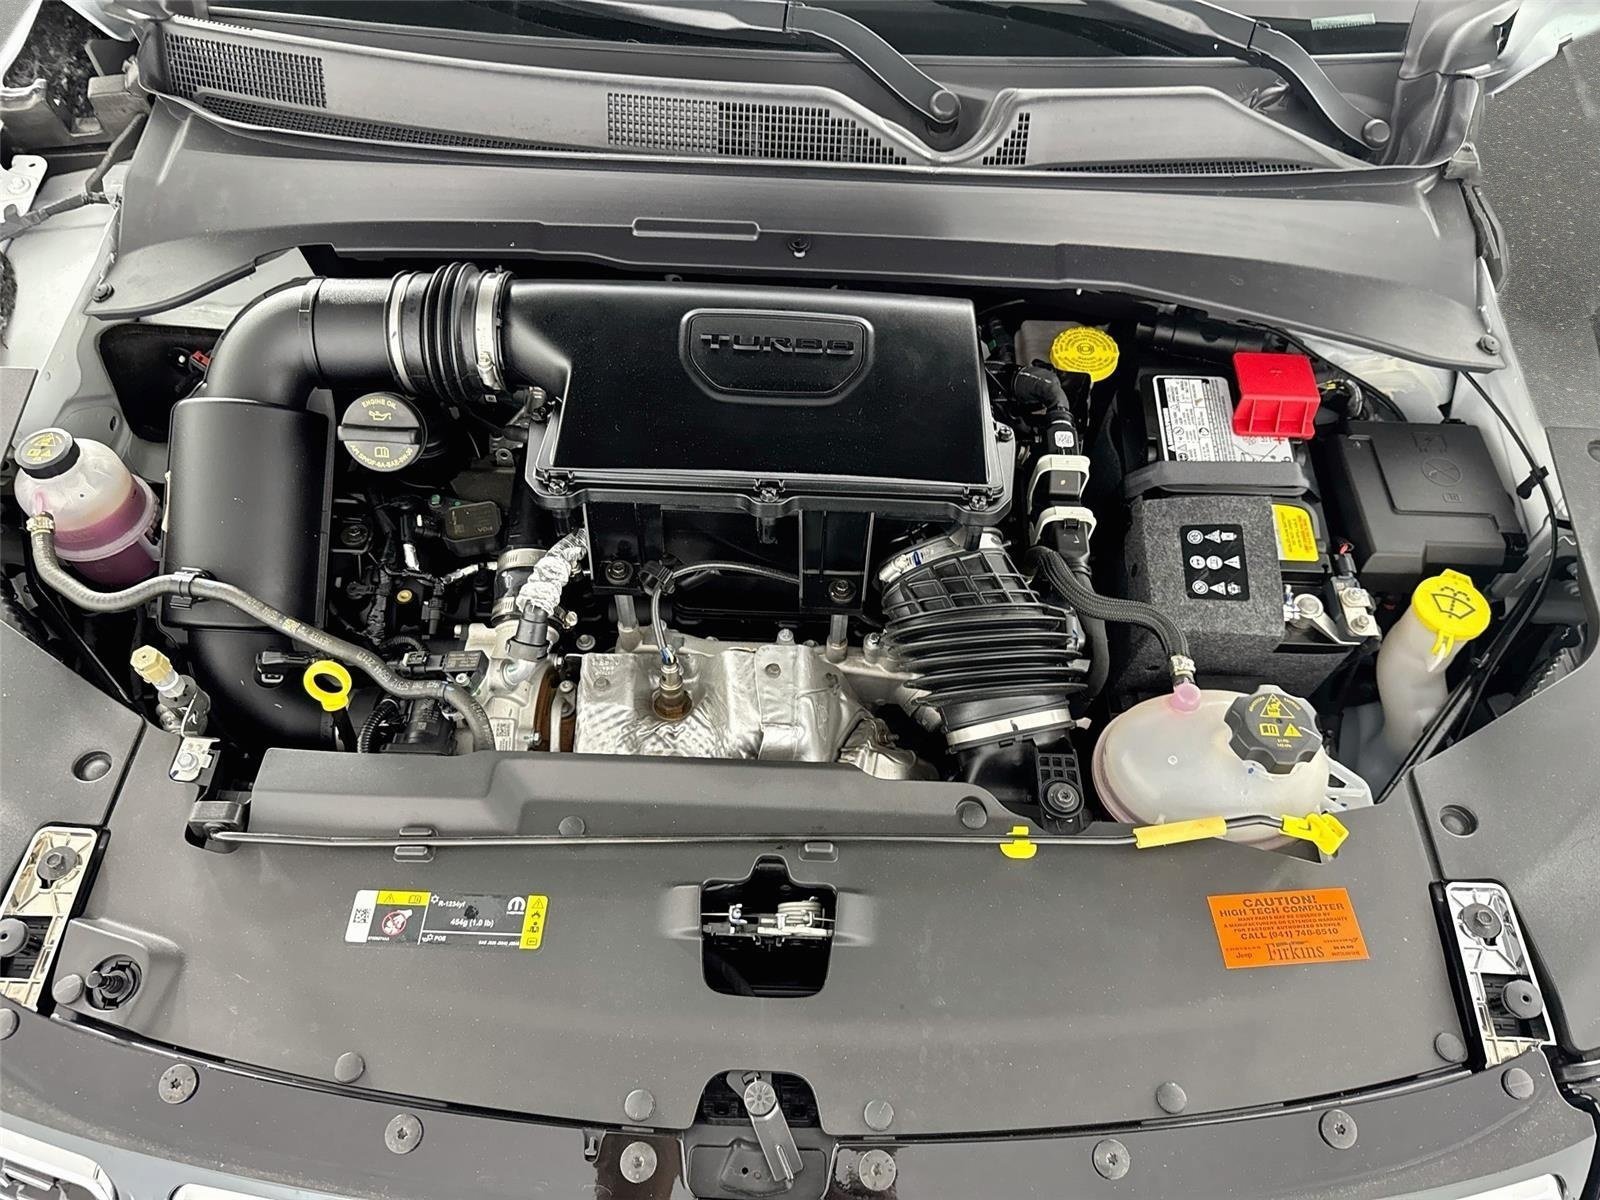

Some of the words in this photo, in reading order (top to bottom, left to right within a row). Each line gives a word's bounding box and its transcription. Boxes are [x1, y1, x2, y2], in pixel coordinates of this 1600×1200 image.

[700, 333, 855, 355] TURBO
[361, 398, 386, 408] ENGINE
[386, 400, 397, 410] OIL
[437, 900, 467, 909] R-1234yf
[1242, 894, 1317, 908] CAUTION!
[1219, 908, 1247, 918] HIGH
[1249, 906, 1280, 916] TECH
[1282, 903, 1345, 913] COMPUTER
[450, 918, 469, 928] 454g
[469, 918, 483, 928] (1.0
[483, 919, 495, 929] lb)
[1240, 932, 1268, 940] CALL
[1266, 942, 1325, 961] Firkins
